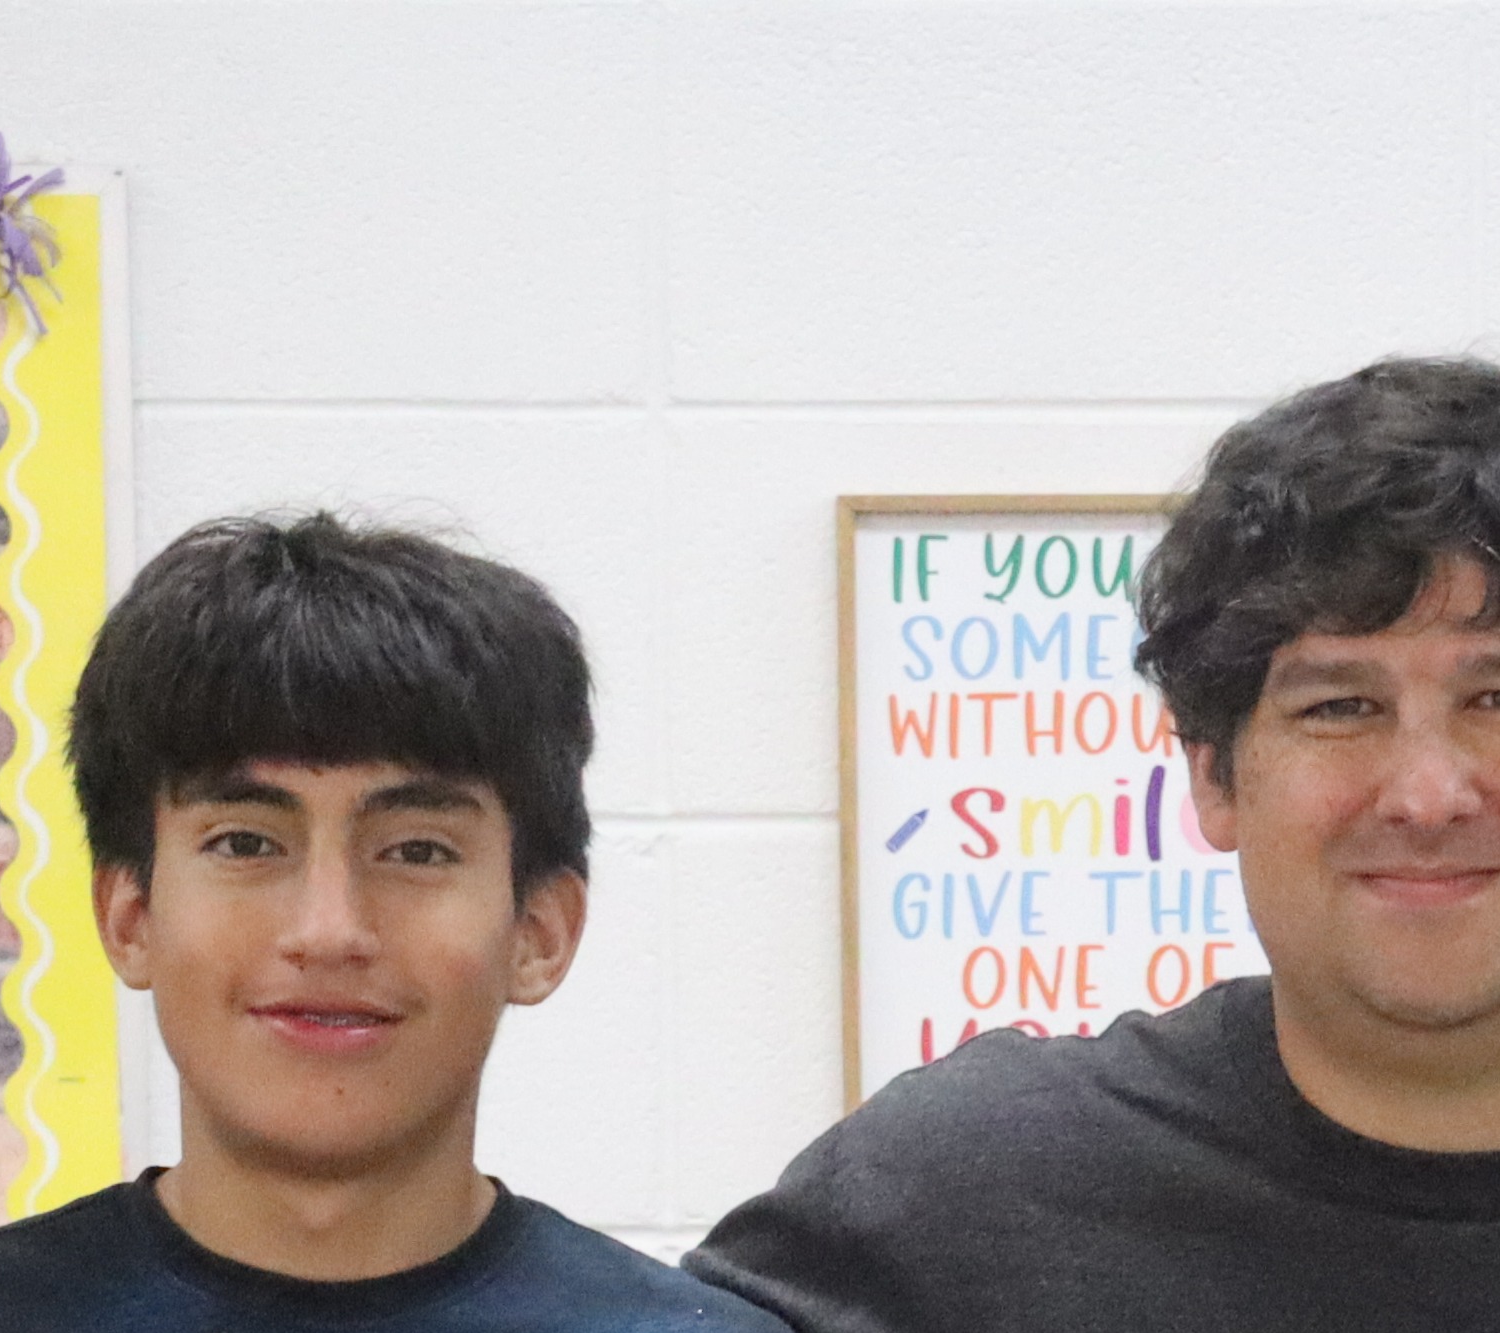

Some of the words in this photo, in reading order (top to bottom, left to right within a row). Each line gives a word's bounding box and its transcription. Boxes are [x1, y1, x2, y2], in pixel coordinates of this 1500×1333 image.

[889, 532, 949, 604] IF
[982, 532, 1139, 605] YOU
[887, 689, 1182, 761] WITHOU
[891, 870, 1052, 941] GIVE
[1088, 868, 1260, 937] THE
[961, 944, 1106, 1013] ONE
[1145, 941, 1237, 1011] OF
